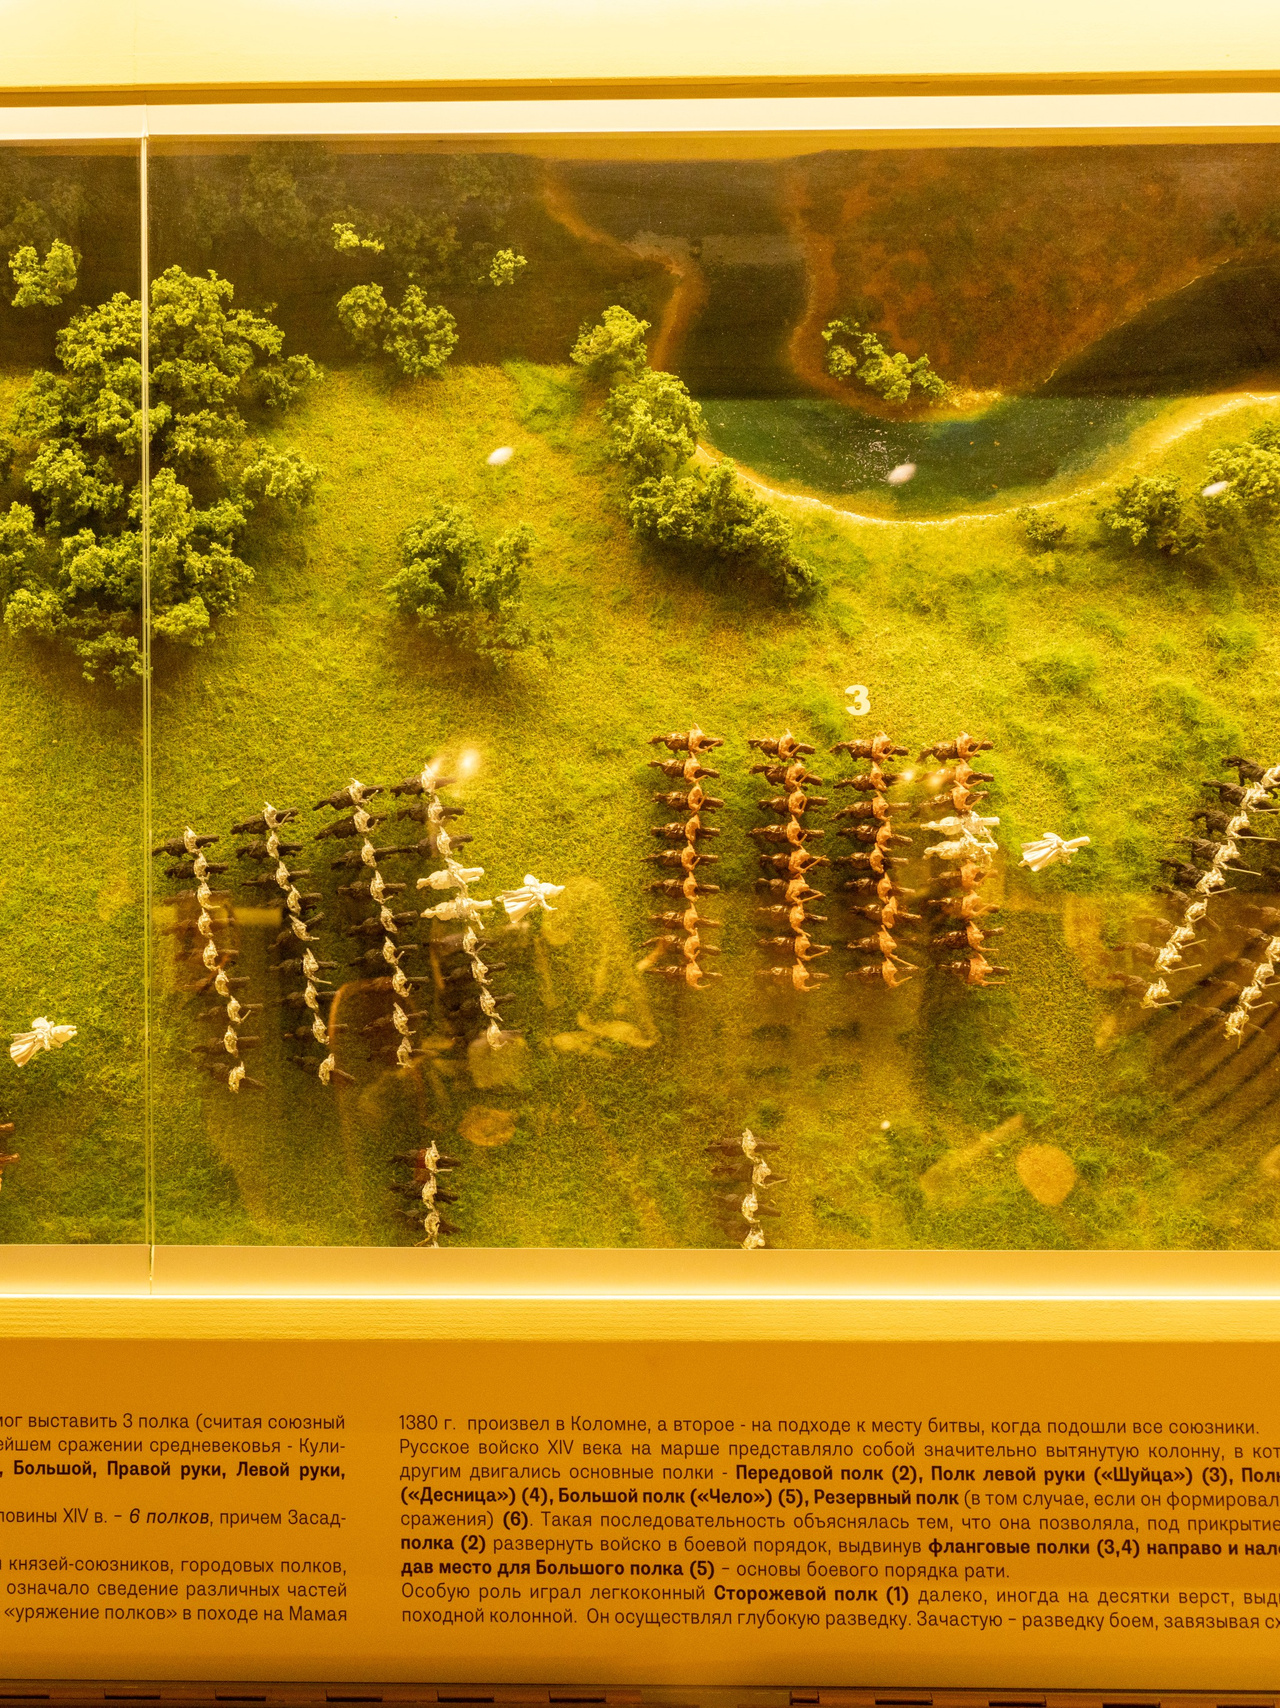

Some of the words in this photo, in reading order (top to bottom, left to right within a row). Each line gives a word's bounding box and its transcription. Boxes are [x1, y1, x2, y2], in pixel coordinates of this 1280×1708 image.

[845, 685, 871, 716] 3
[57, 1439, 144, 1456] сражении
[148, 1439, 281, 1457] средневековья
[298, 1437, 346, 1458] Кули-
[12, 1458, 98, 1480] Большой,
[106, 1459, 172, 1481] Правой
[179, 1463, 227, 1482] руки,
[235, 1460, 291, 1478] Левой
[298, 1464, 346, 1482] руки,
[399, 1485, 517, 1507] («Десница»)
[520, 1486, 555, 1508] (4),
[557, 1486, 639, 1504] Большой
[641, 1490, 686, 1505] полк
[689, 1487, 773, 1509] («Чело»)
[777, 1487, 810, 1509] (5),
[813, 1487, 912, 1510] Резервный
[915, 1492, 960, 1506] полк
[963, 1488, 982, 1510] (в
[984, 1492, 1018, 1507] том
[1022, 1493, 1089, 1511] случае,
[1093, 1493, 1136, 1507] если
[1140, 1493, 1162, 1508] он
[400, 1509, 495, 1531] сражения)
[502, 1510, 534, 1532] (6).
[540, 1510, 593, 1528] Такая
[600, 1514, 786, 1532] последовательность
[792, 1511, 910, 1530] объяснялась
[916, 1516, 954, 1533] тем,
[961, 1516, 992, 1531] что
[998, 1517, 1032, 1531] она
[1038, 1517, 1140, 1534] позволяла,
[1147, 1518, 1181, 1535] под
[8, 1555, 175, 1576] князей-союзников,
[180, 1559, 275, 1577] городовых
[280, 1560, 347, 1577] полков,
[399, 1561, 435, 1578] дав
[438, 1561, 493, 1576] место
[496, 1562, 532, 1579] для
[535, 1558, 626, 1577] Большого
[629, 1562, 685, 1577] полка
[688, 1559, 716, 1581] (5)
[735, 1563, 801, 1578] основы
[806, 1559, 880, 1578] боевого
[884, 1564, 960, 1582] порядка
[963, 1565, 1010, 1583] рати.
[5, 1582, 91, 1596] означало
[96, 1582, 179, 1600] сведение
[185, 1583, 281, 1601] различных
[286, 1581, 348, 1598] частей
[400, 1581, 471, 1603] Особую
[478, 1586, 522, 1603] роль
[529, 1586, 582, 1604] играл
[589, 1584, 706, 1601] легкоконный
[713, 1583, 827, 1606] Сторожевой
[833, 1588, 879, 1602] полк
[885, 1585, 910, 1607] (1)
[917, 1589, 988, 1606] далеко,
[996, 1590, 1060, 1607] иногда
[1067, 1590, 1090, 1604] на
[1096, 1590, 1170, 1608] десятки
[1178, 1591, 1235, 1609] верст,
[1243, 1591, 1280, 1608] выд
